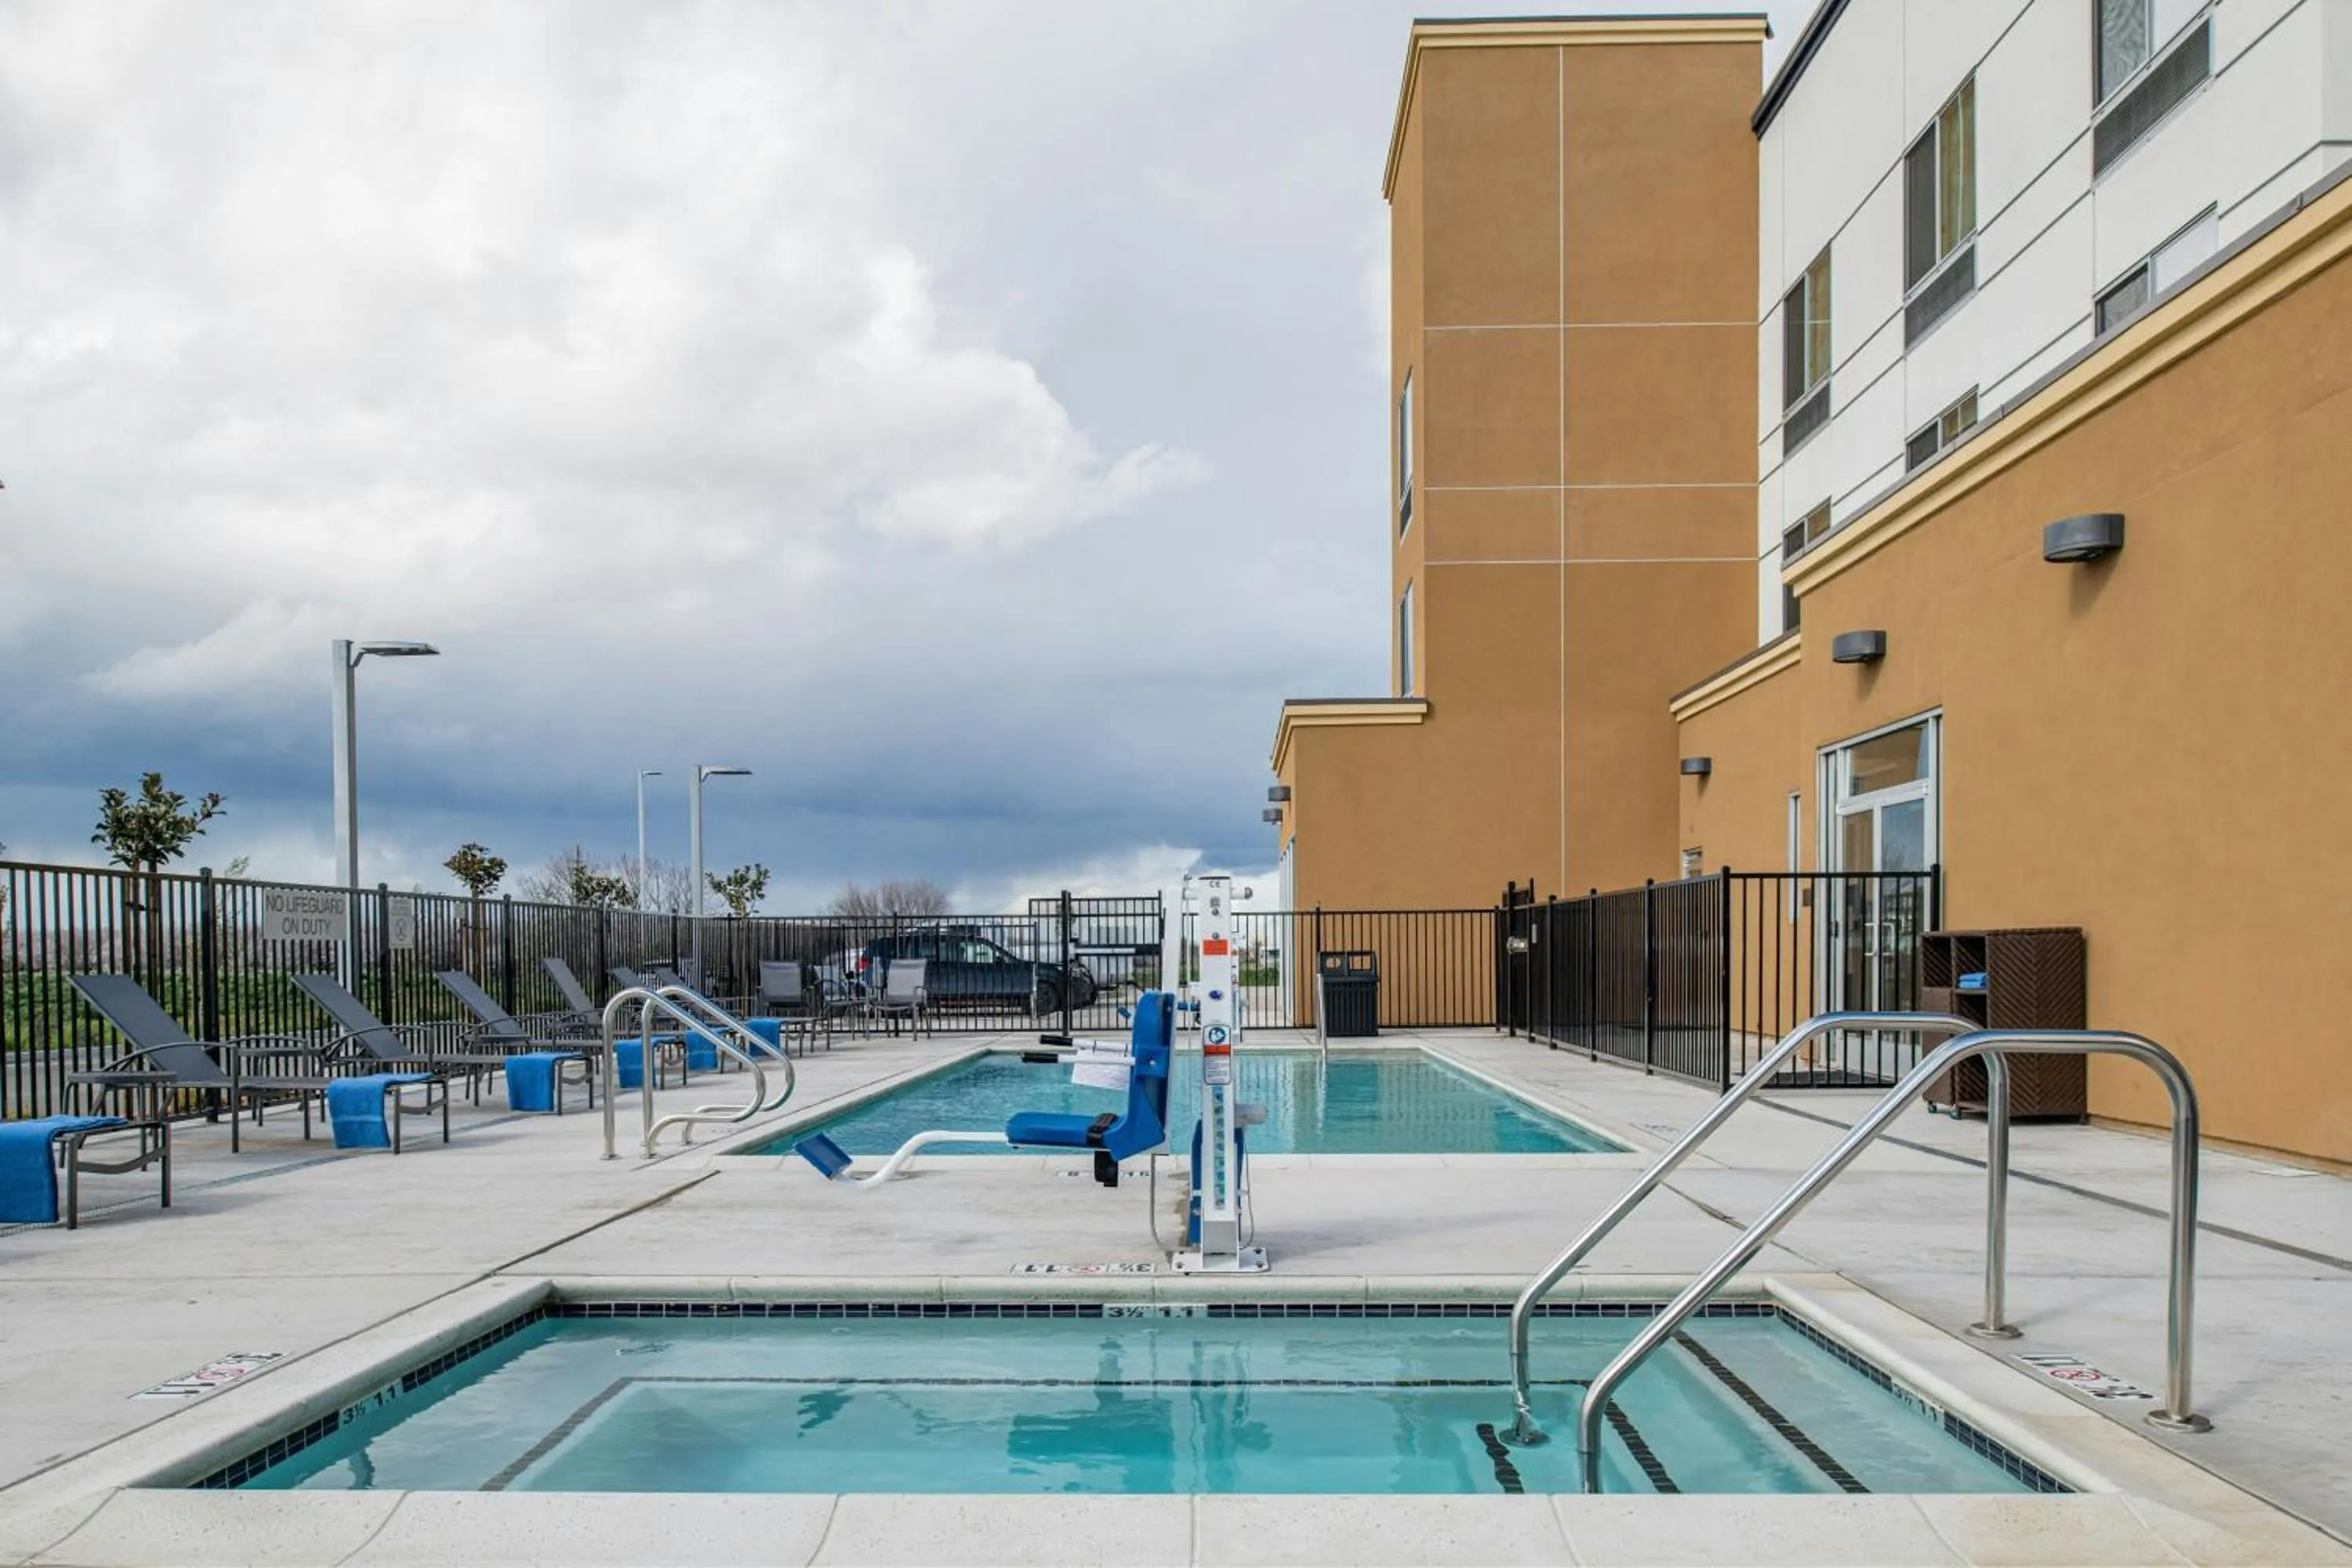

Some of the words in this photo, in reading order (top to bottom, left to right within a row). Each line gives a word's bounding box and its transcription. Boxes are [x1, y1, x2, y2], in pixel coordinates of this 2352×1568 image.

[267, 895, 284, 912] NO
[286, 896, 344, 914] LIFEGUARD
[282, 916, 299, 935] ON
[303, 918, 331, 935] DUTY
